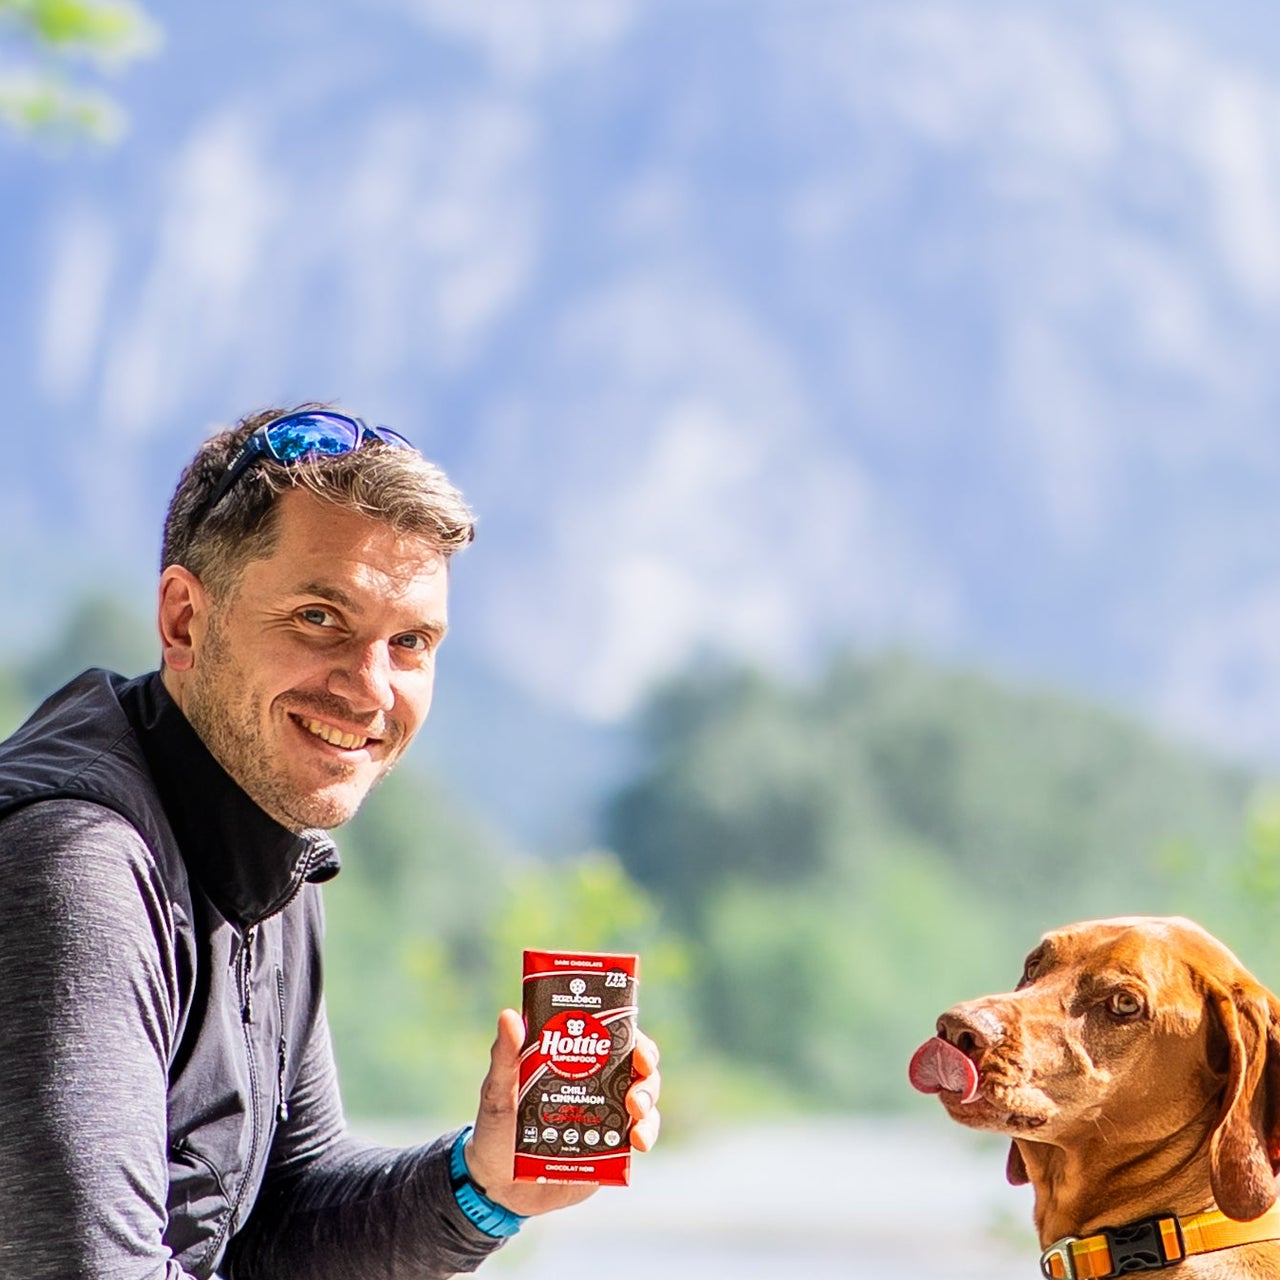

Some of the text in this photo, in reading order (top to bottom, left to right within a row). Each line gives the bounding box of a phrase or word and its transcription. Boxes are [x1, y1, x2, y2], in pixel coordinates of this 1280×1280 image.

[570, 960, 603, 968] CHOCOLATE
[540, 1030, 612, 1056] Hottie
[552, 1055, 597, 1063] SUPERFOOD
[560, 1085, 587, 1095] CHILI
[541, 1092, 605, 1105] & CINNAMON
[545, 1164, 595, 1173] CHOCOLAT NOIR
